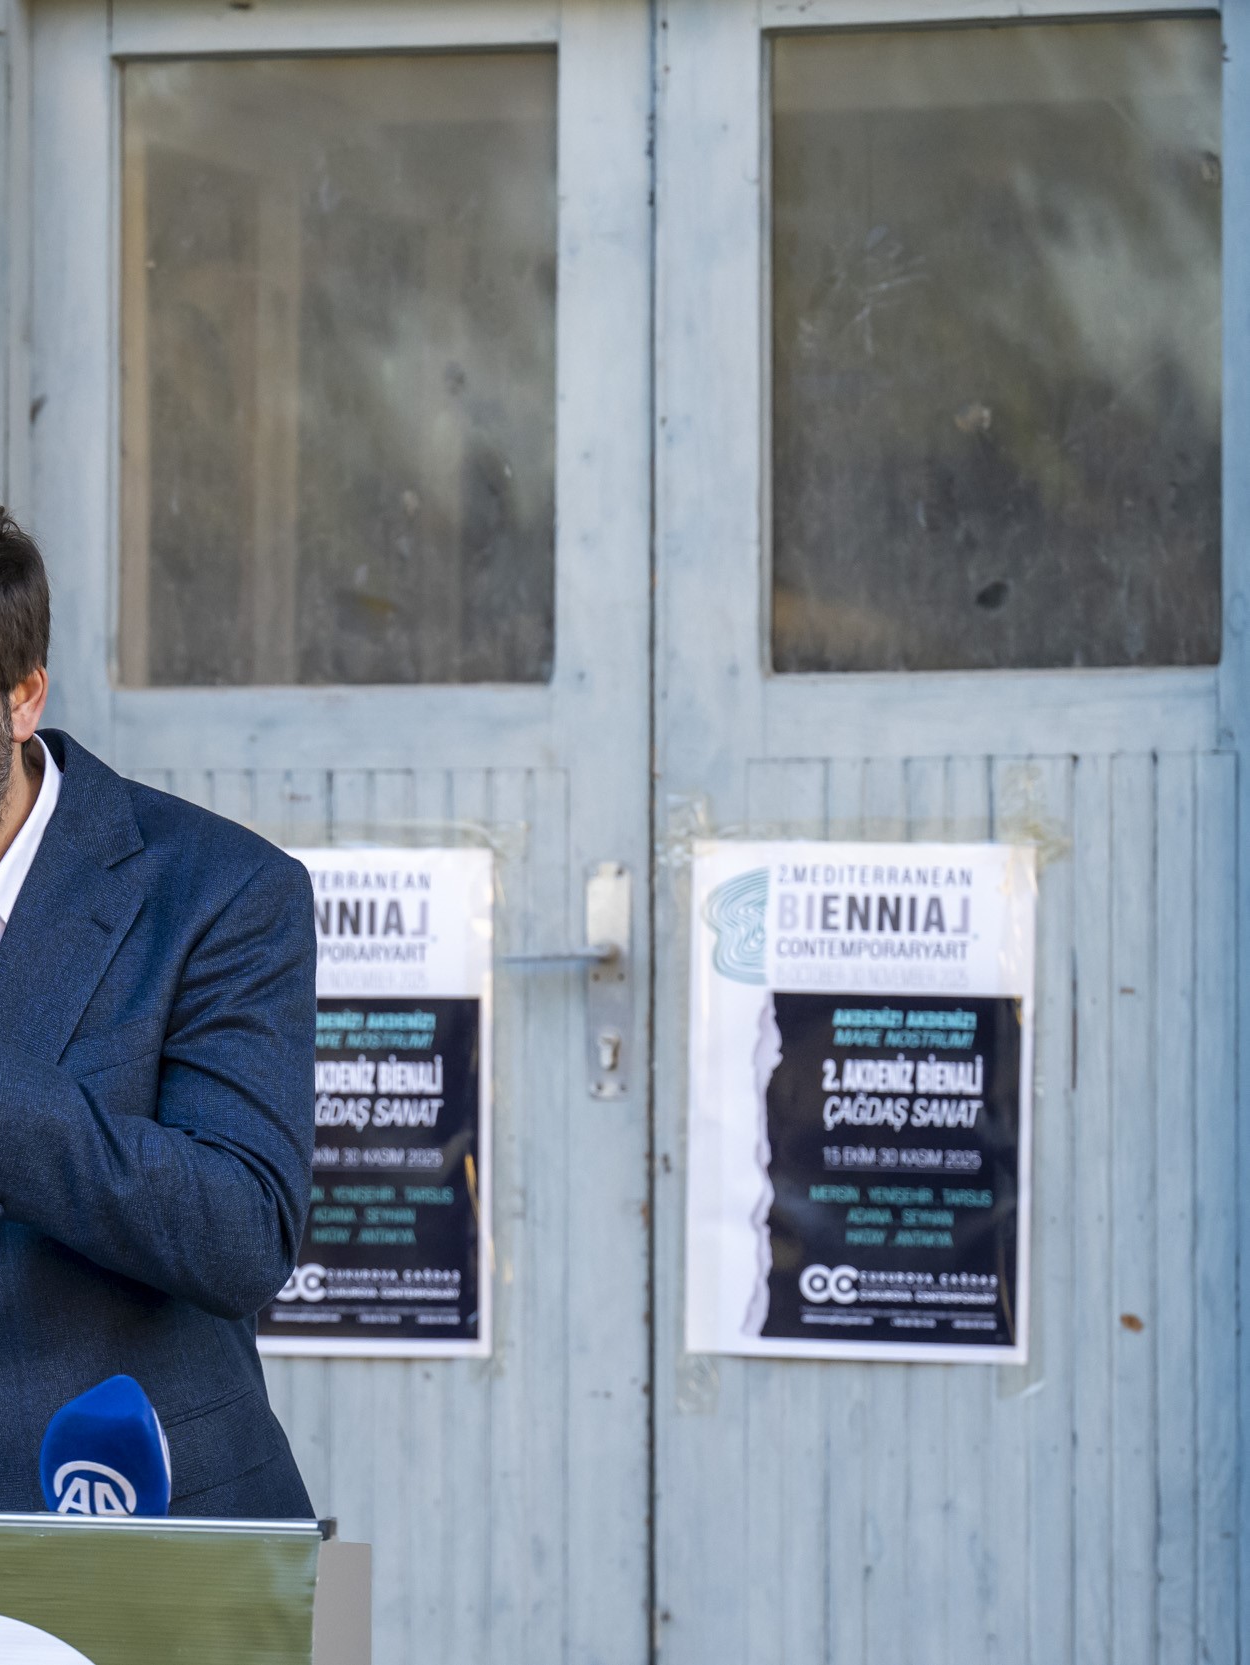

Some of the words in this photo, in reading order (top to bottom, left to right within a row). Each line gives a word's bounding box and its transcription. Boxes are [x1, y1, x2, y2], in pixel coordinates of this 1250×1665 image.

[822, 1058, 840, 1092] 2.
[315, 1092, 371, 1132] ĞDAŞ
[372, 1097, 444, 1127] SANAT
[823, 1092, 909, 1132] ÇAĞDAŞ
[910, 1099, 984, 1128] SANAT
[57, 1476, 128, 1515] AA
